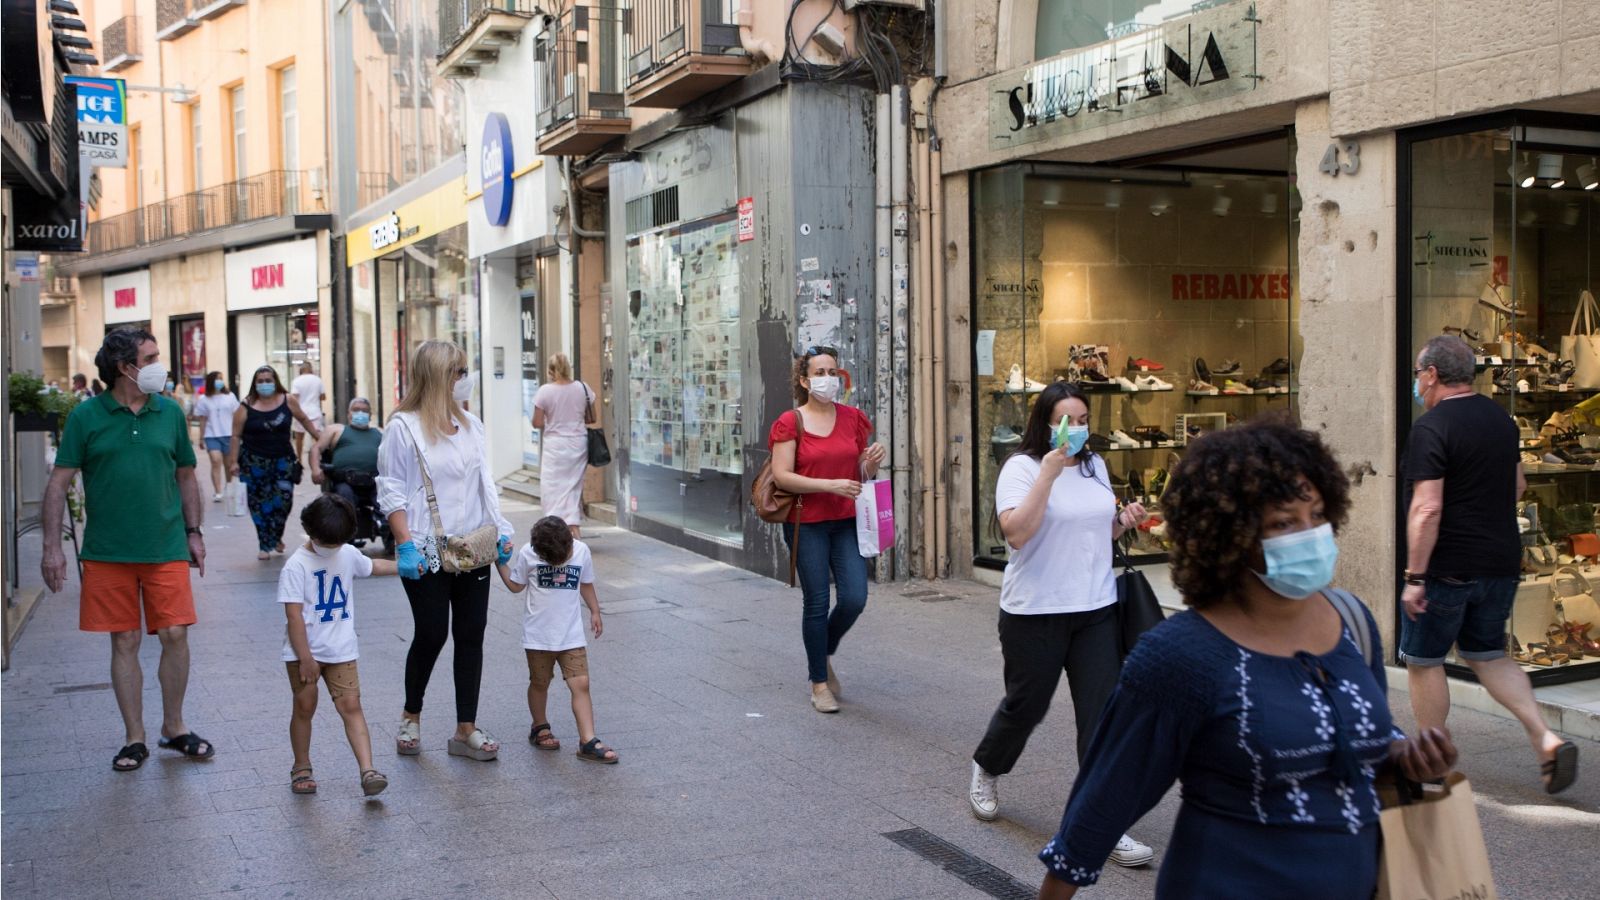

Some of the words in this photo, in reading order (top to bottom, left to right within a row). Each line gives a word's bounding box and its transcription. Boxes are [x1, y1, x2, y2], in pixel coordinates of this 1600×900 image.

[1319, 140, 1361, 177] 43
[18, 218, 77, 239] xarol
[1171, 273, 1293, 301] REBAIXES
[313, 569, 350, 623] LA
